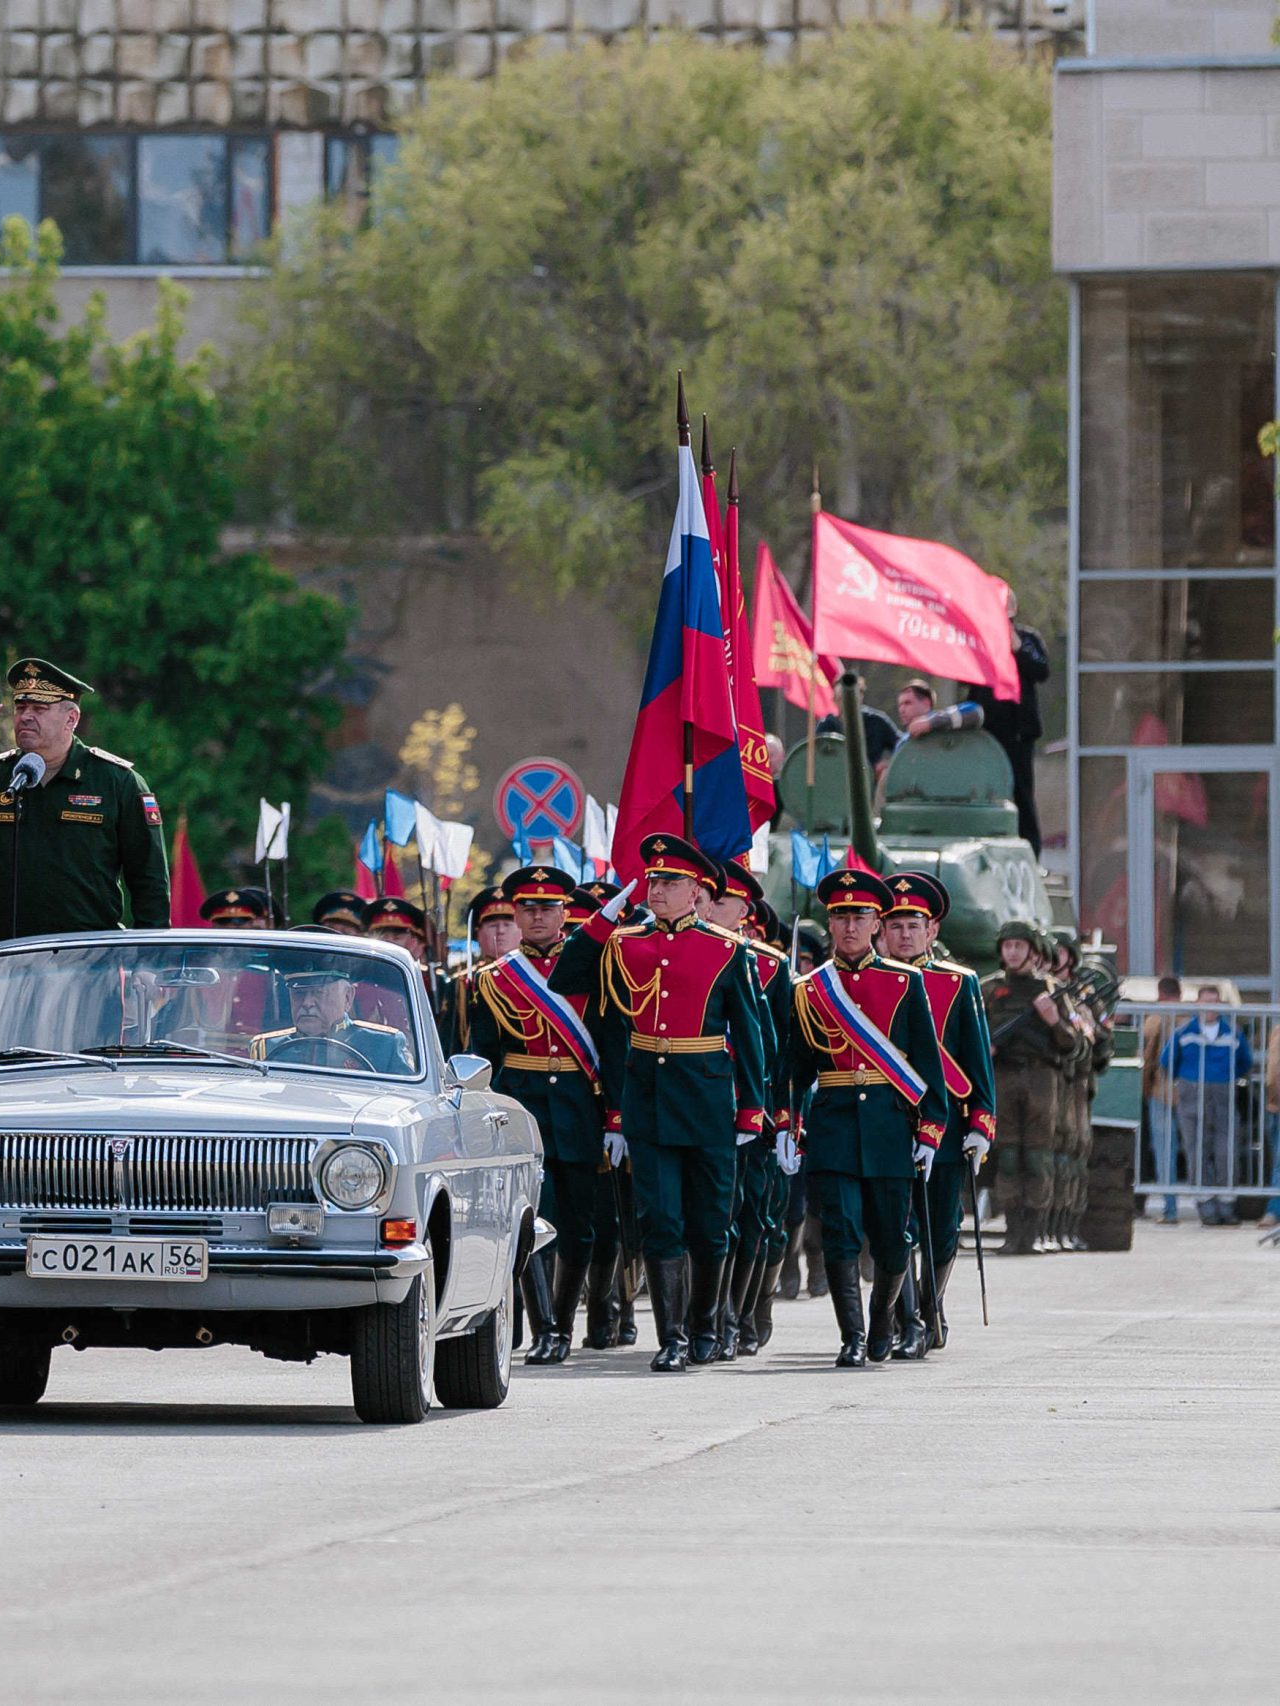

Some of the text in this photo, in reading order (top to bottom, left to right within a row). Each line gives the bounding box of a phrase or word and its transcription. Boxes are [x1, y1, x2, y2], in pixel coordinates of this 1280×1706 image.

[42, 1244, 197, 1273] С021АК 56
[164, 1266, 186, 1275] RUS
